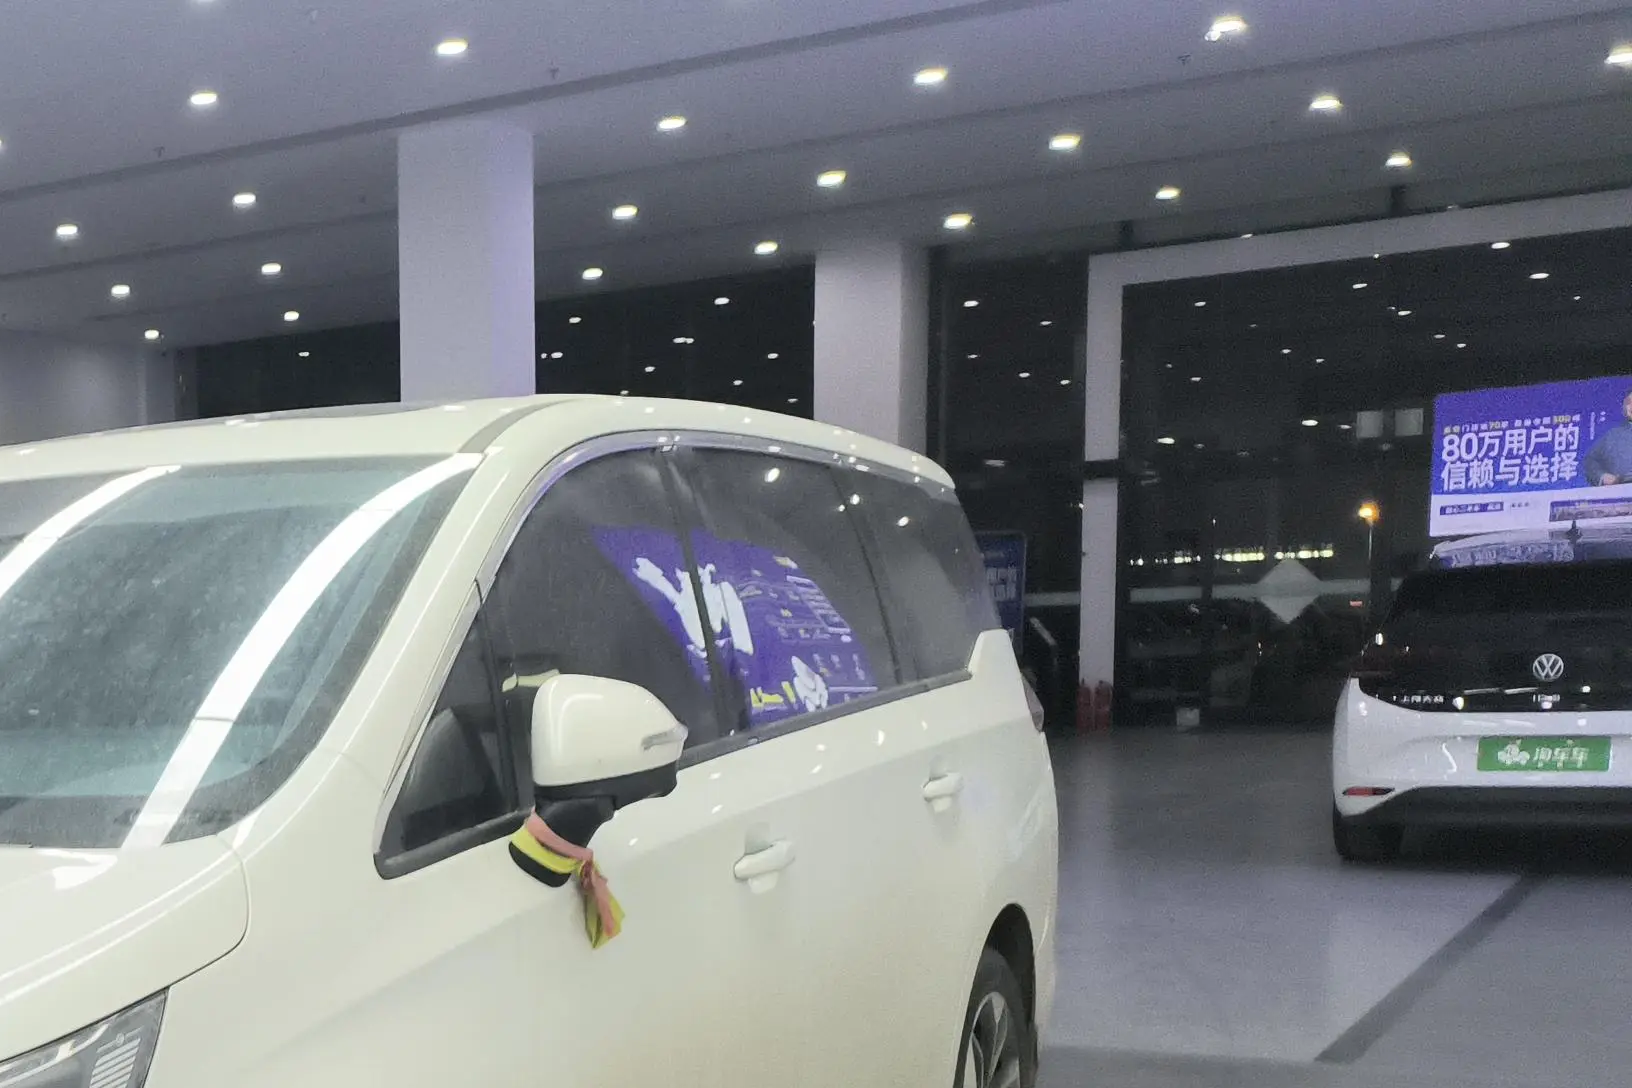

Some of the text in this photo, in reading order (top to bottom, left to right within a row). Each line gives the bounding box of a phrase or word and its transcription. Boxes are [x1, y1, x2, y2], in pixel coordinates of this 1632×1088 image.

[1441, 423, 1580, 462] 80万用户的
[1440, 451, 1579, 492] 信赖与选择
